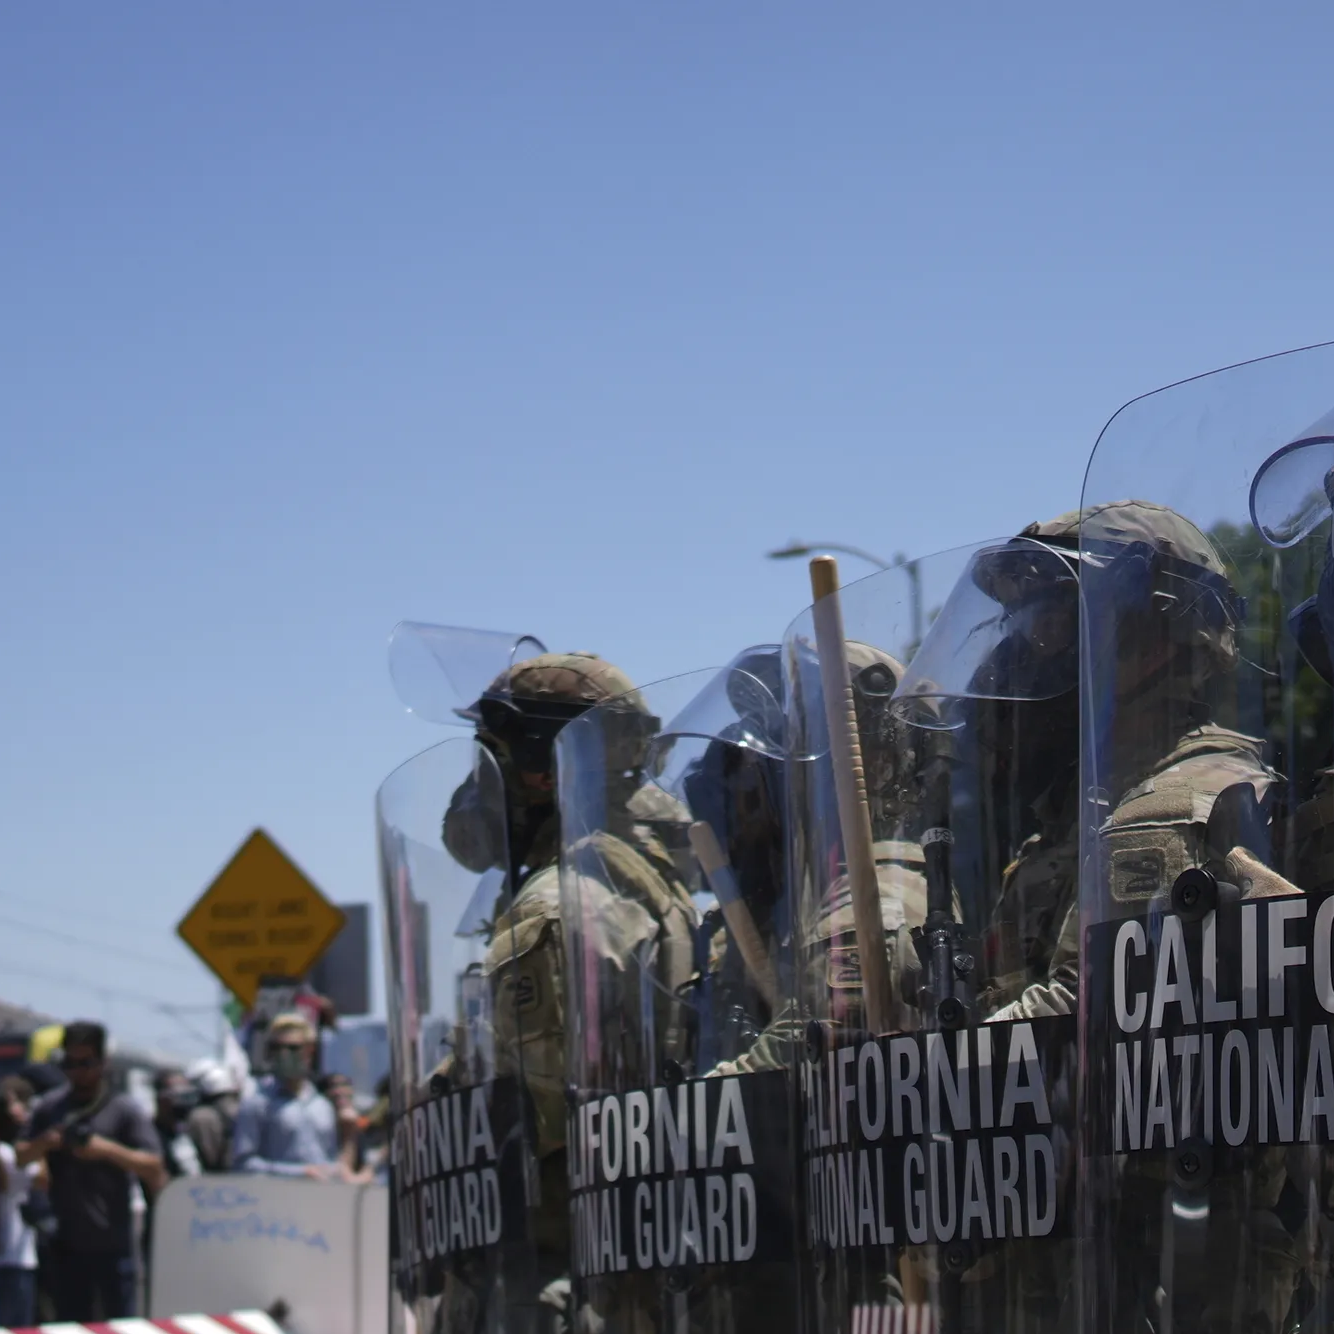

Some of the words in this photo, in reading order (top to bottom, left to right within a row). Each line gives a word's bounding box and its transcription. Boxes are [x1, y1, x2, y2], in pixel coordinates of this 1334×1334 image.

[421, 1167, 502, 1261] GUARD
[635, 1172, 757, 1269] GUARD
[903, 1133, 1057, 1244] GUARD
